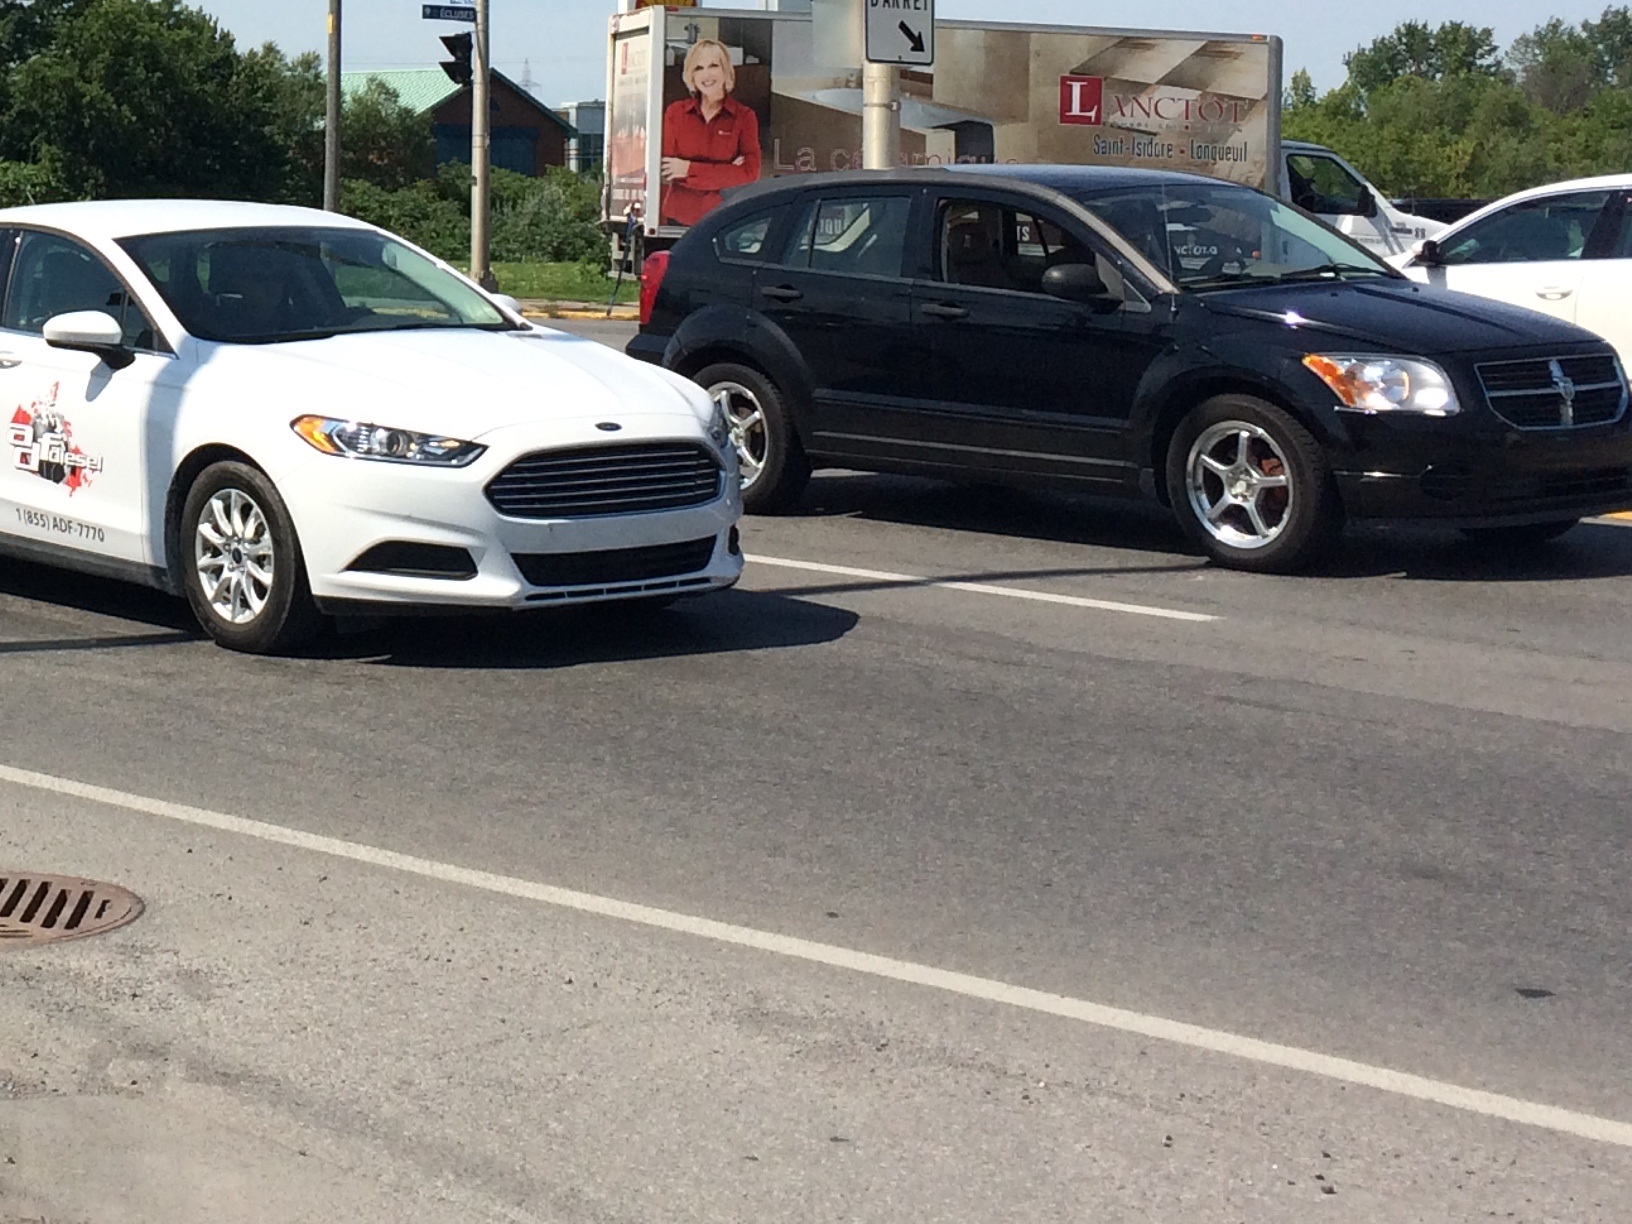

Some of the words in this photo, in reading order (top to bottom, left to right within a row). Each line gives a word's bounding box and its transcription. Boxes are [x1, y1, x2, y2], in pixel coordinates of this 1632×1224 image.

[774, 138, 817, 171] La
[1093, 133, 1174, 159] Saint-Isidore
[1189, 139, 1249, 165] Longueuil
[52, 517, 106, 543] ADF-7770
